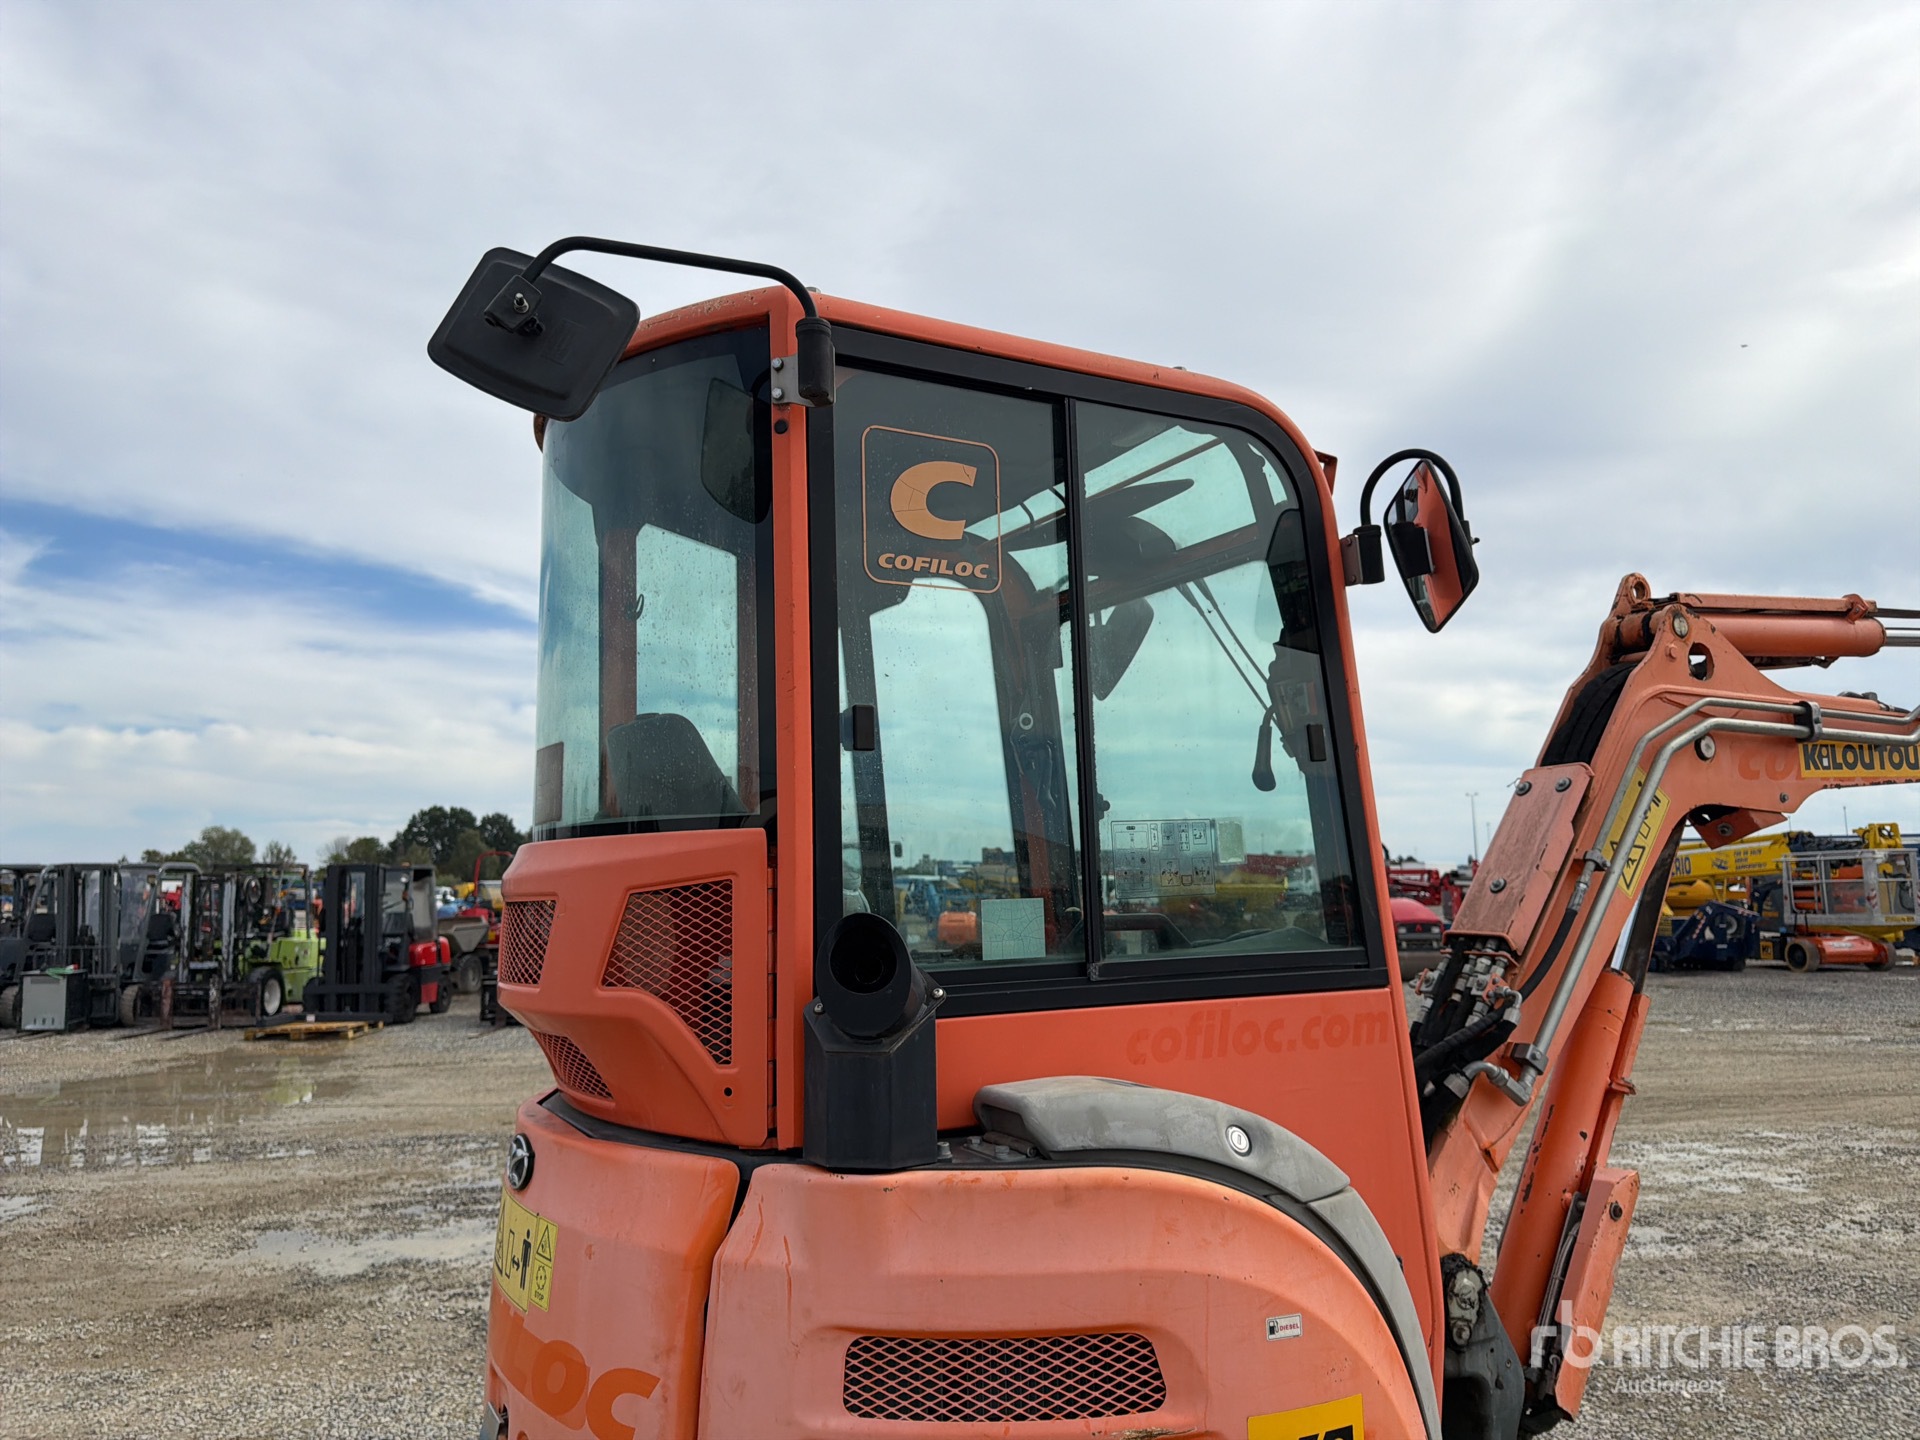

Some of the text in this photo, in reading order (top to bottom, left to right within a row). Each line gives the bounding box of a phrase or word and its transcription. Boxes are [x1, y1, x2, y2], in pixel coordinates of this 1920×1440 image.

[890, 461, 977, 540] C
[878, 553, 989, 579] COFILOC
[1126, 1008, 1389, 1066] cofiloc.com
[1279, 1323, 1300, 1331] DIESEL
